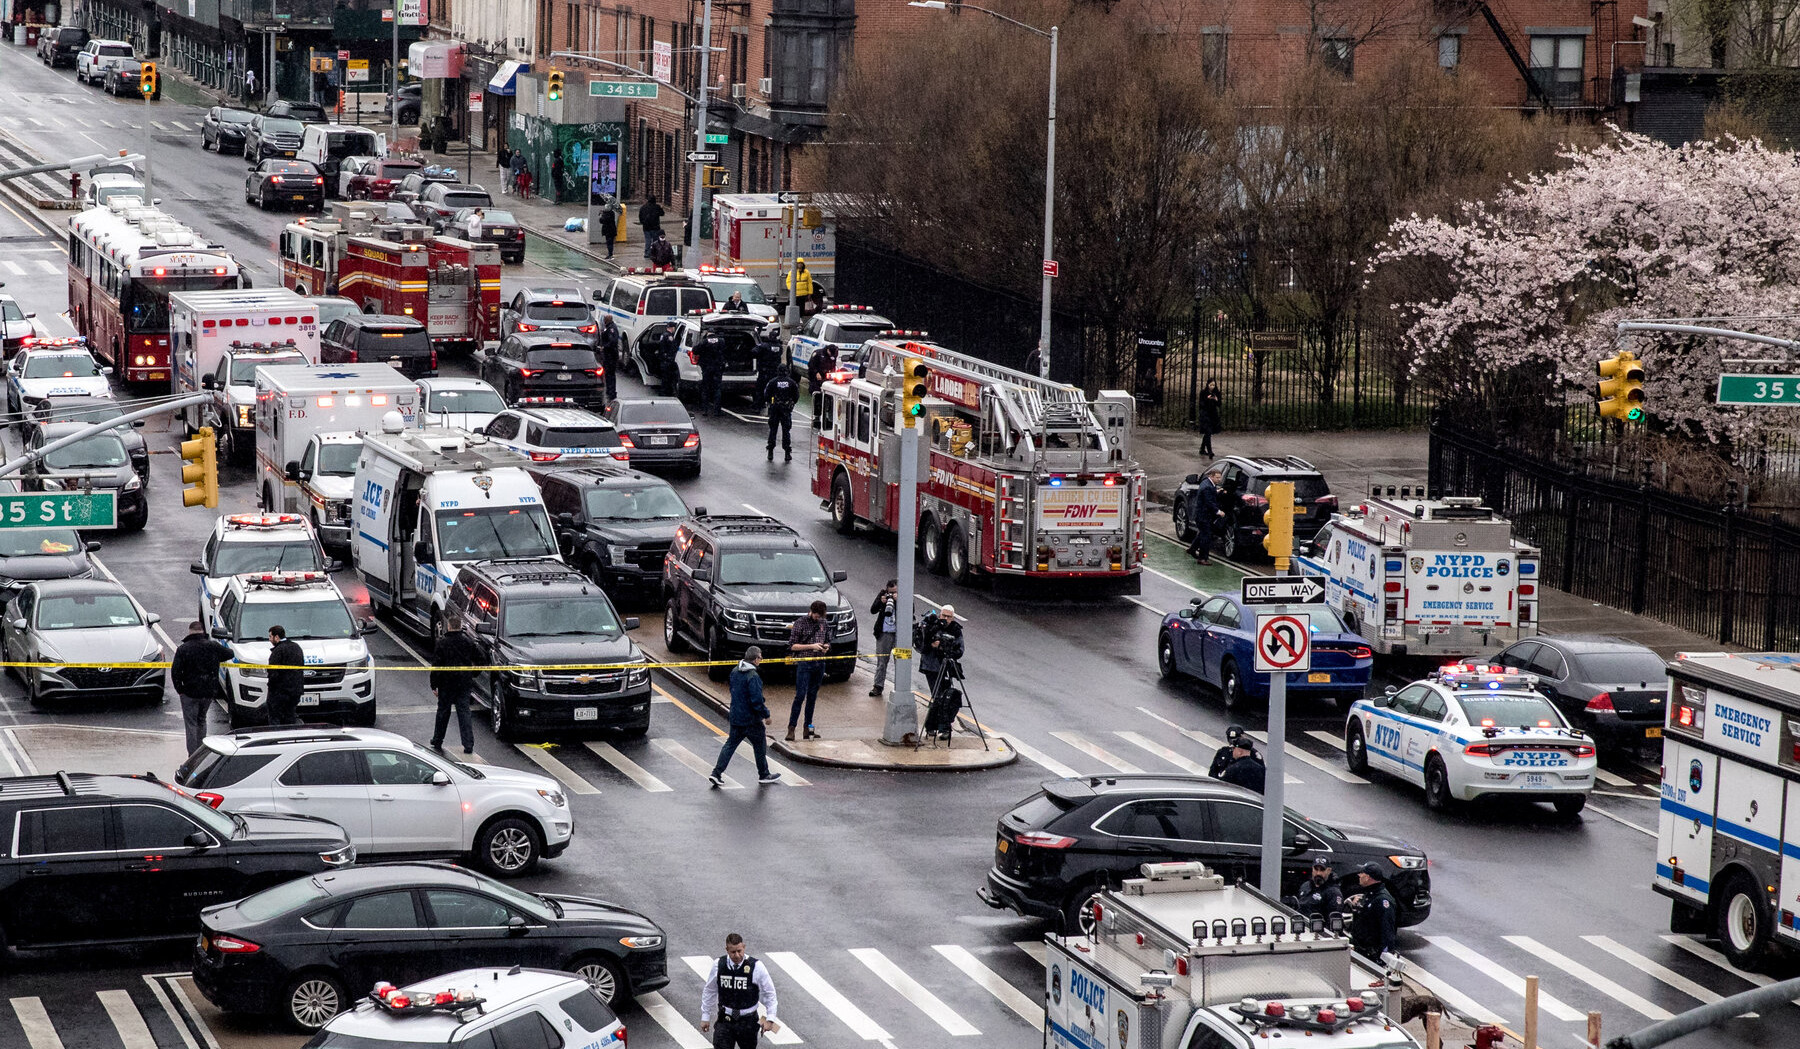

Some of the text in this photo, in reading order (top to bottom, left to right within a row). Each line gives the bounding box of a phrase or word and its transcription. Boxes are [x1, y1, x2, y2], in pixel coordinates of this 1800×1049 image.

[607, 85, 642, 95] 34 St
[364, 249, 384, 261] SQUAD
[935, 376, 963, 399] LADDER
[1753, 382, 1785, 399] 35
[289, 405, 308, 418] F.D.
[936, 469, 955, 487] FDNY
[1043, 491, 1085, 503] LADDER
[1103, 491, 1119, 502] 109
[40, 500, 72, 521] St
[1064, 505, 1097, 518] FDNY
[1347, 539, 1366, 562] POLICE
[1435, 555, 1485, 566] NYPD
[1426, 567, 1493, 578] POLICE
[417, 570, 433, 594] NYPD
[1249, 585, 1316, 596] ONE WAY
[1423, 601, 1494, 610] EMERGENCY SERVICE
[1715, 704, 1771, 733] EMERGENCY
[1374, 724, 1401, 751] NYPD
[1722, 723, 1761, 747] SERVICE
[720, 977, 749, 990] POLICE
[1070, 968, 1105, 1015] POLICE
